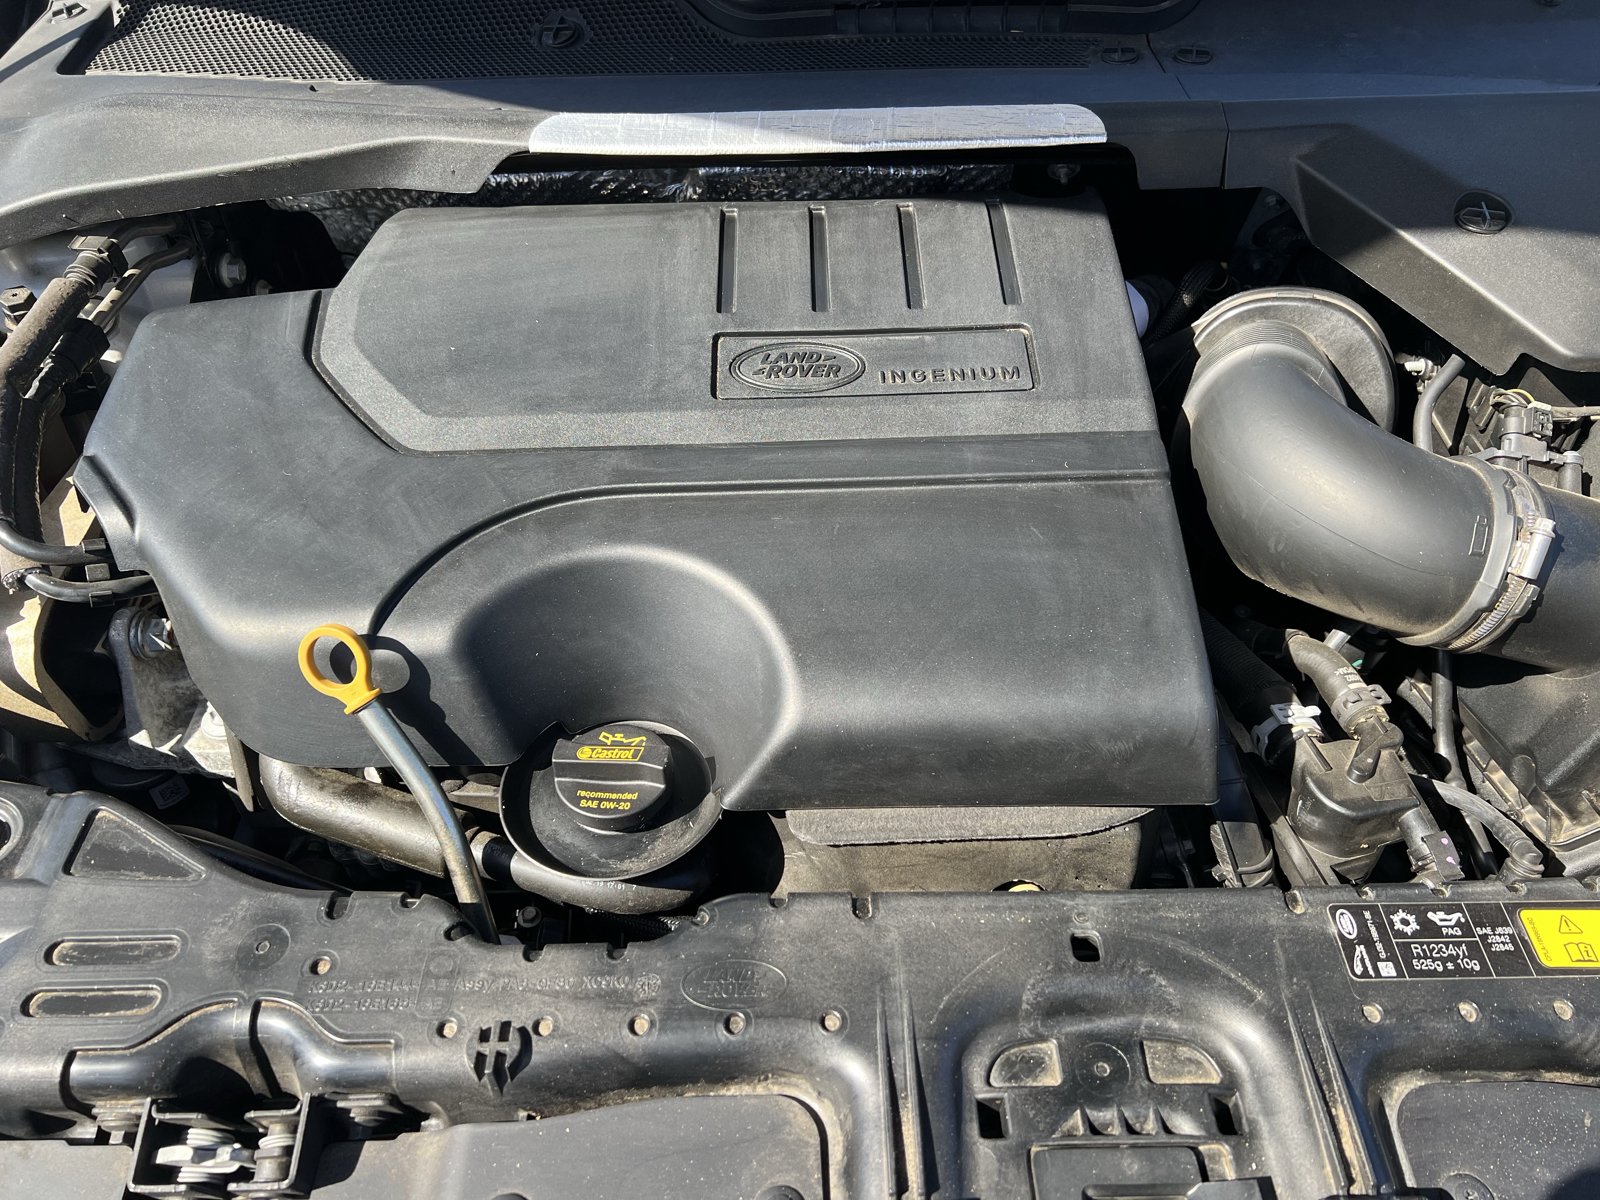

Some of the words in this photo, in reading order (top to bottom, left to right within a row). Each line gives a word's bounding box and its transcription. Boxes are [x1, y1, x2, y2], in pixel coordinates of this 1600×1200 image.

[760, 351, 822, 365] LAND
[765, 363, 841, 379] ROVER
[879, 365, 1021, 384] INGENIUM
[591, 748, 635, 759] Castrol
[577, 790, 638, 800] recommended
[580, 800, 599, 808] SAE
[600, 801, 631, 810] 0W-20
[1441, 927, 1462, 936] PAG
[1476, 927, 1494, 935] SAE
[1410, 943, 1468, 959] R1234yf
[1412, 959, 1443, 972] 525g
[1456, 958, 1481, 971] 10g
